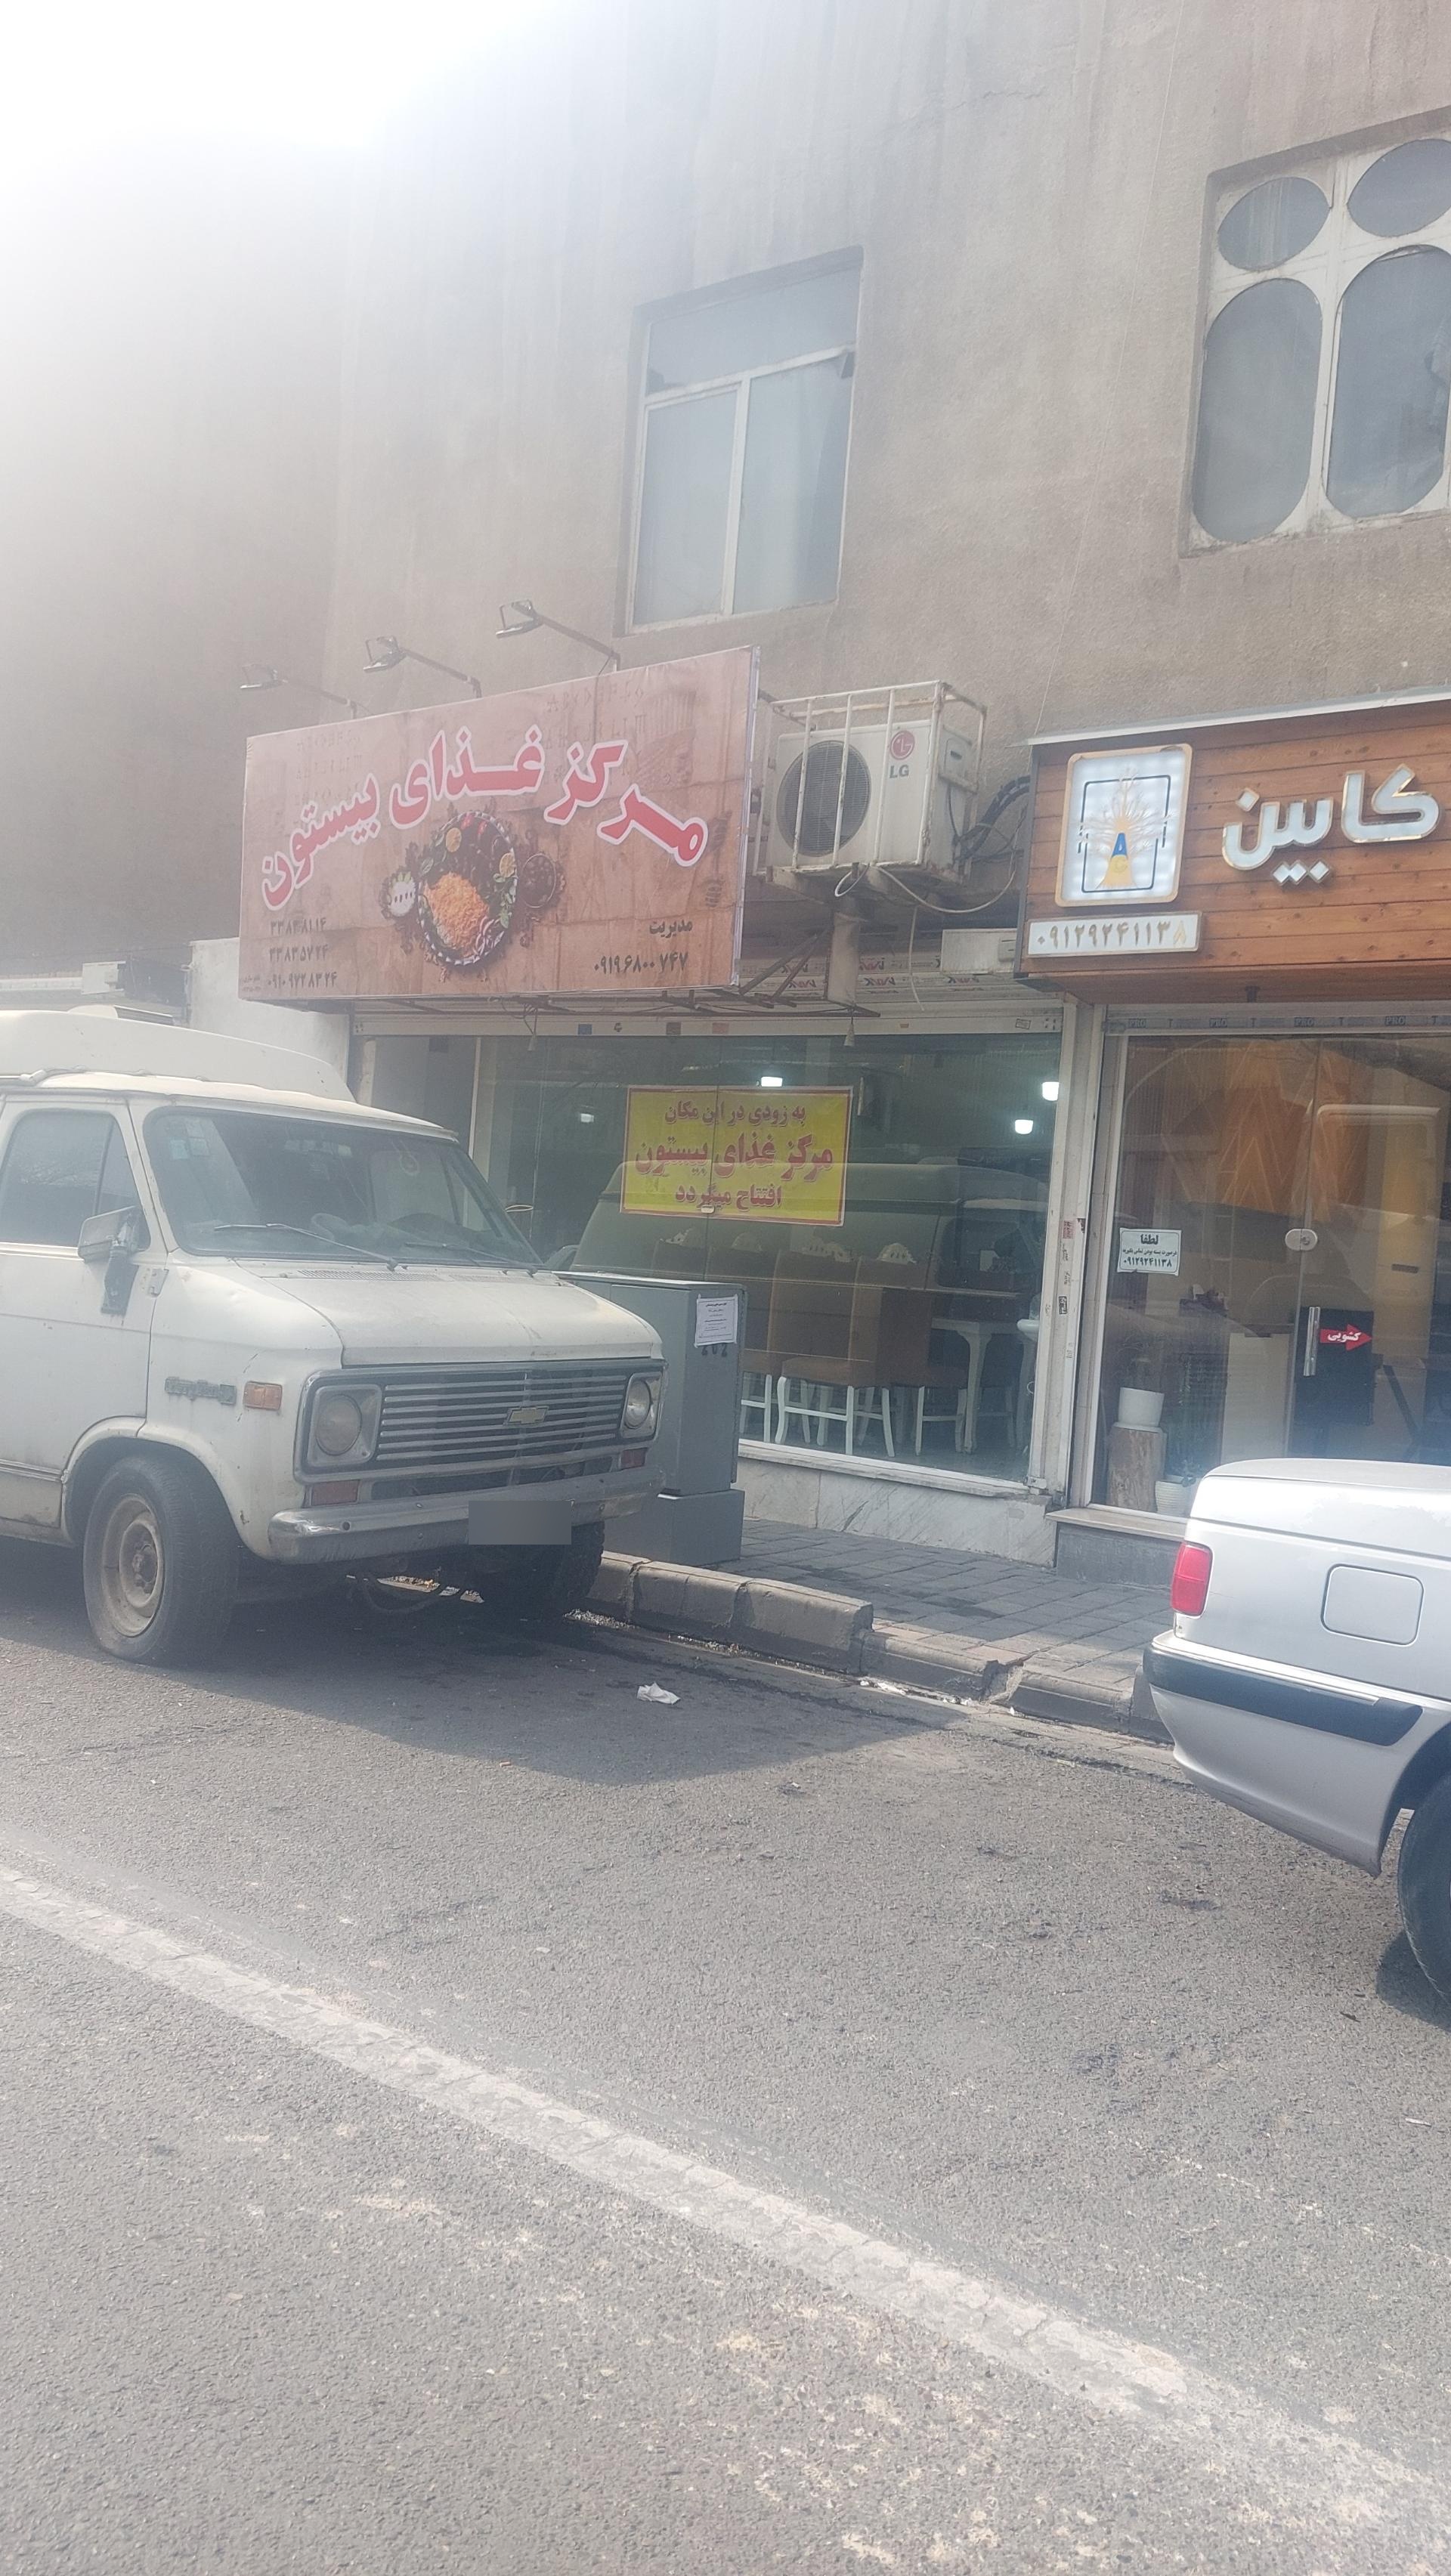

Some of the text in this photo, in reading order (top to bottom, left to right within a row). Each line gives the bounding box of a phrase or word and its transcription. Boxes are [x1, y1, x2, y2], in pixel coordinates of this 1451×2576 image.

[889, 765, 910, 779] LG
[261, 724, 708, 911] مرکز غذای بیستون
[1221, 763, 1441, 885] کابین
[649, 920, 693, 939] مدیریت
[1037, 920, 1187, 949] ۰۹۱۲۹۲۴۱۱۳۸
[665, 1100, 806, 1127] به زودی در این مکان
[634, 1131, 834, 1182] مرکز غذای بیستون
[736, 1183, 782, 1212] افتتاح
[1140, 1233, 1159, 1245] لطفا
[1123, 1257, 1172, 1267] ۰۹۱۲۹۲۴۱۱۳۸
[1327, 1331, 1362, 1343] کشویی
